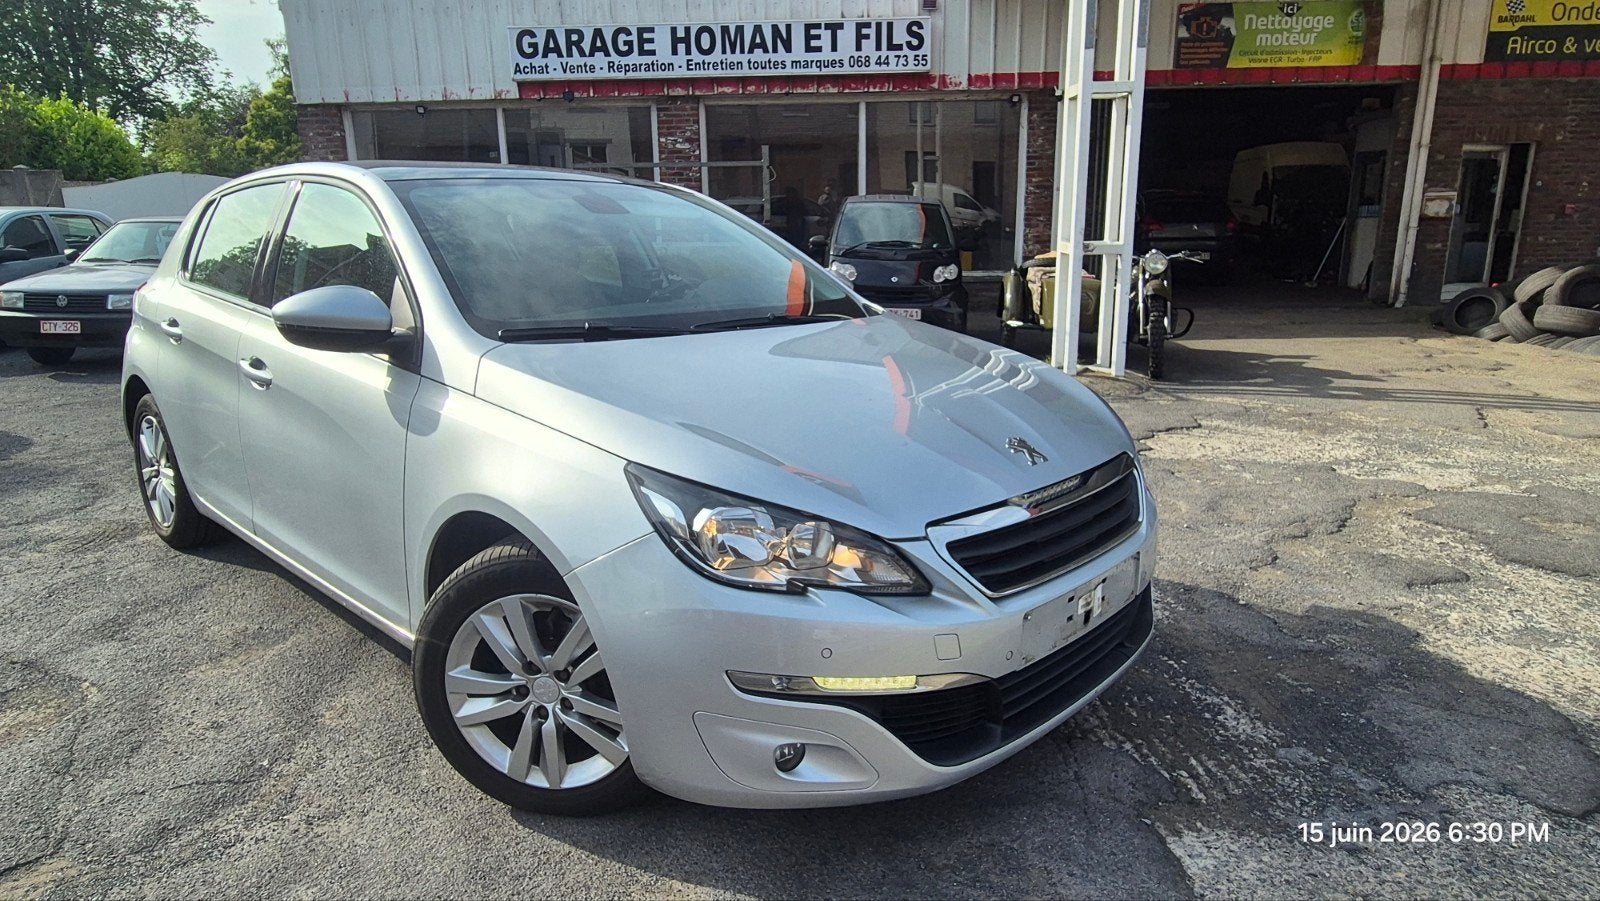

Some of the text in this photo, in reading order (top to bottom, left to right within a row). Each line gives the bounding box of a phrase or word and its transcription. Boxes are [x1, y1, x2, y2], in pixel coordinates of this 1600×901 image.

[1283, 3, 1298, 14] ici
[1498, 14, 1537, 26] BARDAHL
[515, 20, 925, 59] GARAGE HOMAN ET FILS
[1256, 32, 1318, 46] moteur
[1506, 36, 1557, 55] Airco
[1563, 36, 1578, 54] &
[513, 62, 550, 75] Achat
[560, 61, 596, 73] Vente
[607, 59, 674, 76] Réparation
[686, 58, 743, 71] Entretien
[748, 58, 787, 70] toutes
[791, 58, 844, 72] marques
[849, 55, 871, 68] 068
[875, 55, 890, 68] 44
[894, 54, 909, 67] 73
[913, 54, 928, 67] 55
[42, 322, 78, 331] CTY-326
